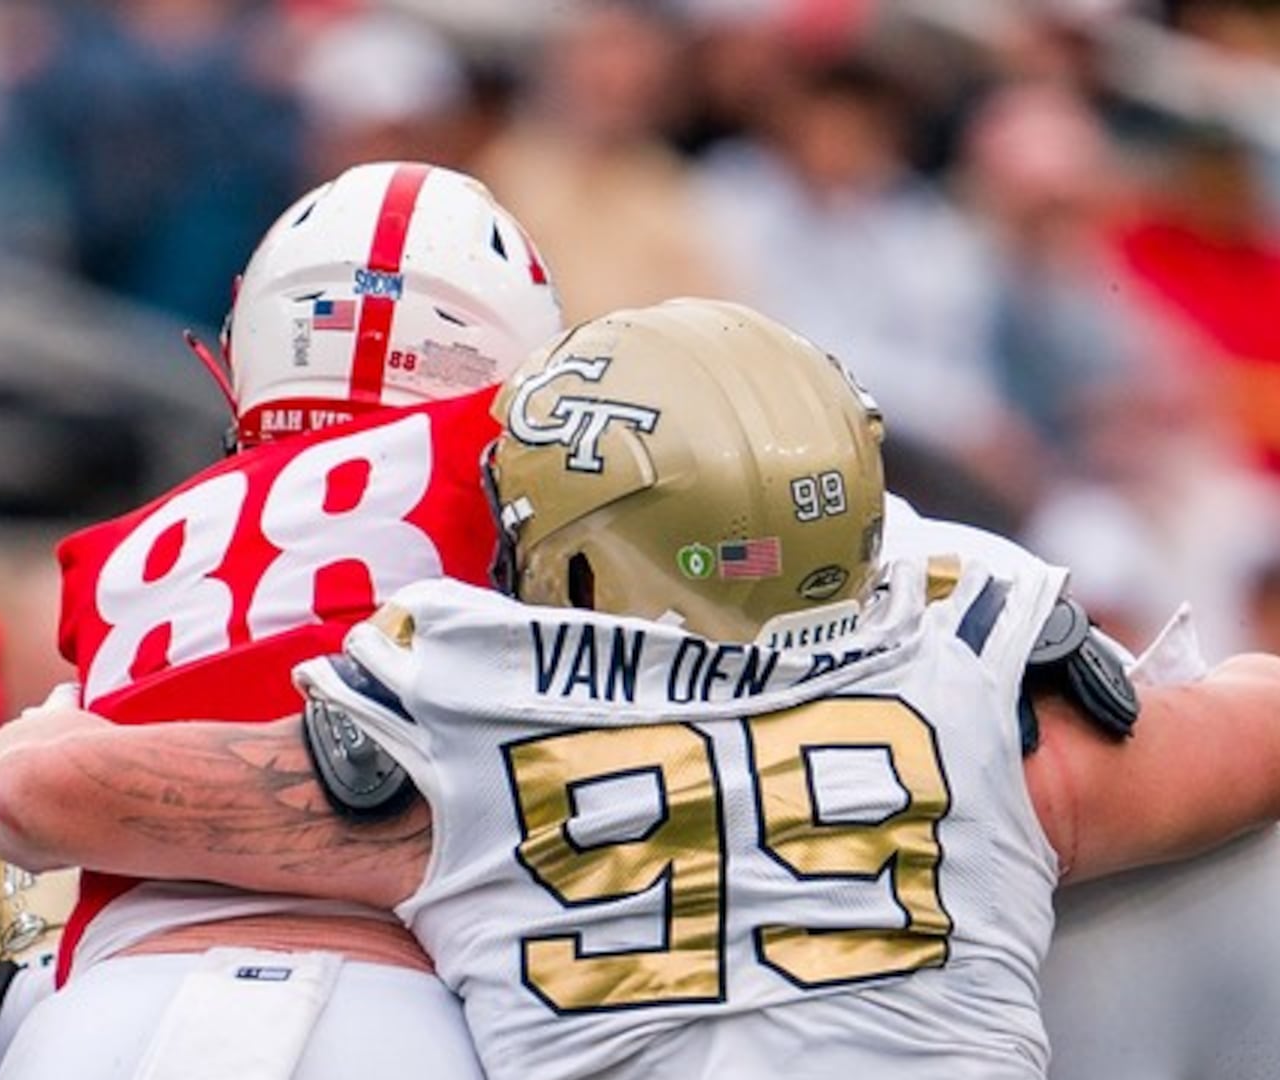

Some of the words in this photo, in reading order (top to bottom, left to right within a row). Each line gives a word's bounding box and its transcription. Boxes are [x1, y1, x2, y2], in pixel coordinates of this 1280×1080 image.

[388, 351, 416, 371] 88
[508, 356, 660, 474] GT
[790, 470, 847, 522] 99
[83, 412, 444, 709] 88
[530, 620, 647, 702] VAN
[498, 692, 952, 1017] 99
